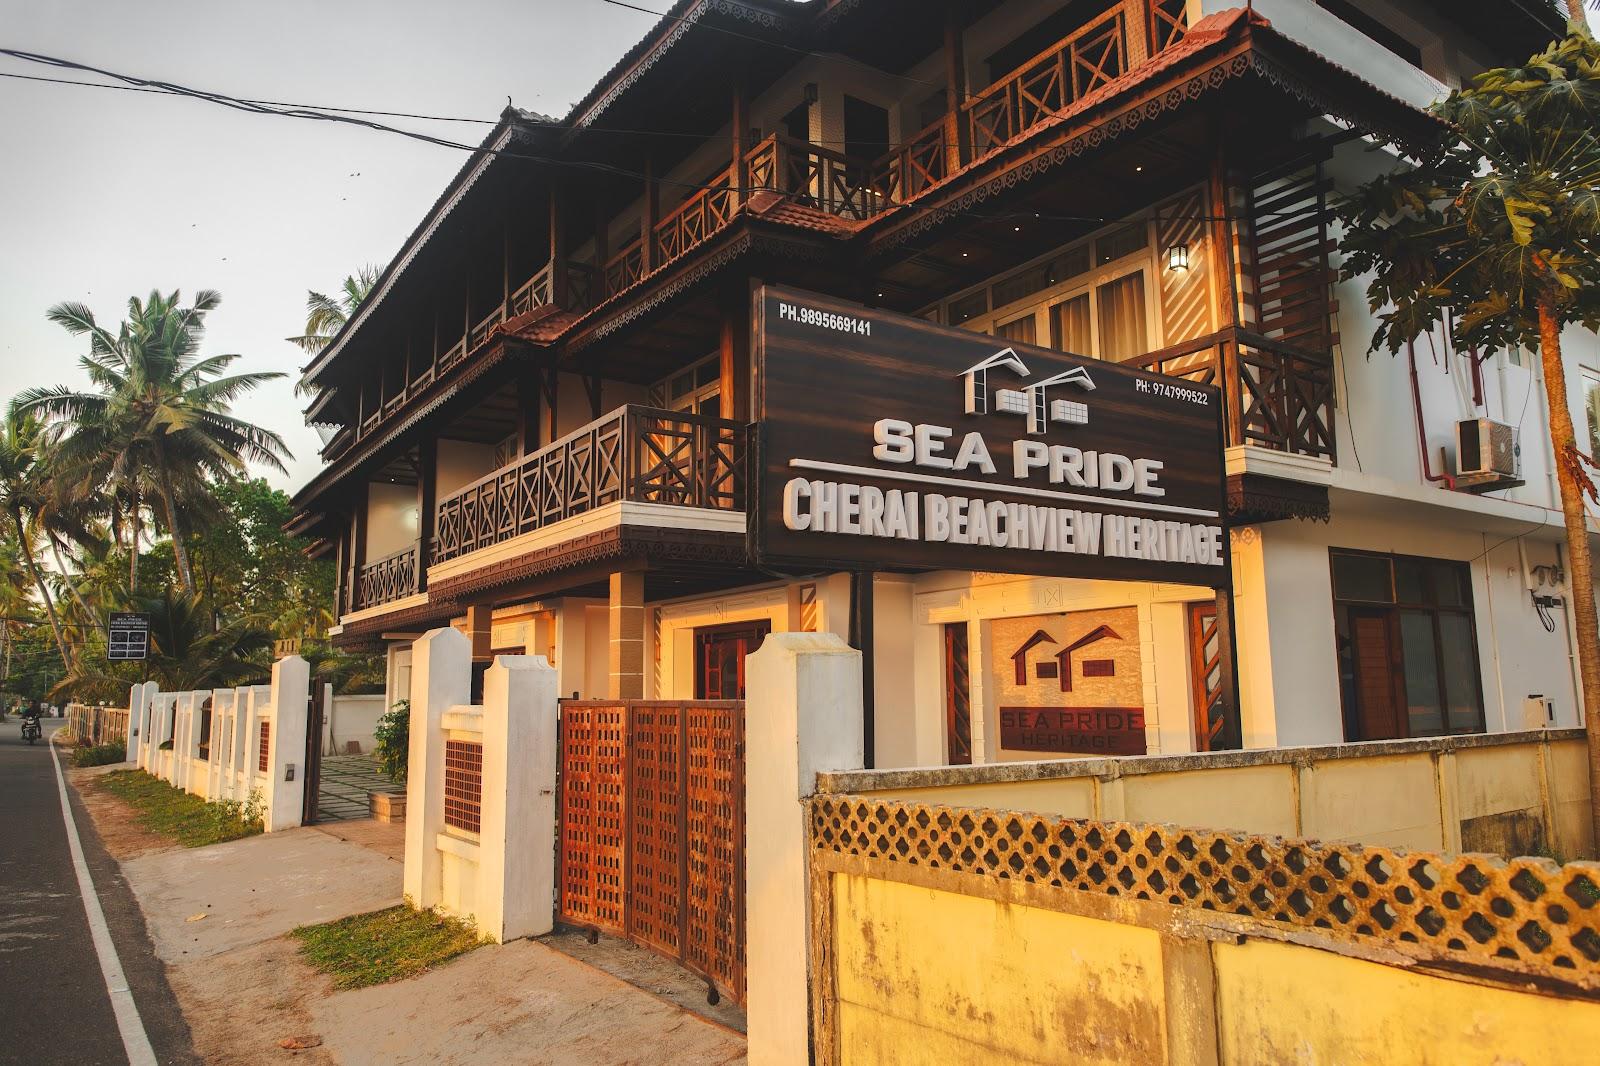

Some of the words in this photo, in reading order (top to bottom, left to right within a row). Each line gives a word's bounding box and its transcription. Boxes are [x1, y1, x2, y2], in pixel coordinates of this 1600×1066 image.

[779, 302, 871, 336] PH.9895669141
[1135, 378, 1151, 394] PH:
[1152, 382, 1209, 406] 9747999522
[872, 418, 997, 475] SEA
[1012, 439, 1166, 497] PRIDE
[782, 477, 920, 541] CHERAI
[923, 492, 1102, 556] BEACHVIEW
[1103, 513, 1224, 566] HERITAGE
[1001, 711, 1050, 729] SEA
[1058, 710, 1144, 731] PRIDE
[1021, 732, 1120, 749] HERITAGE
